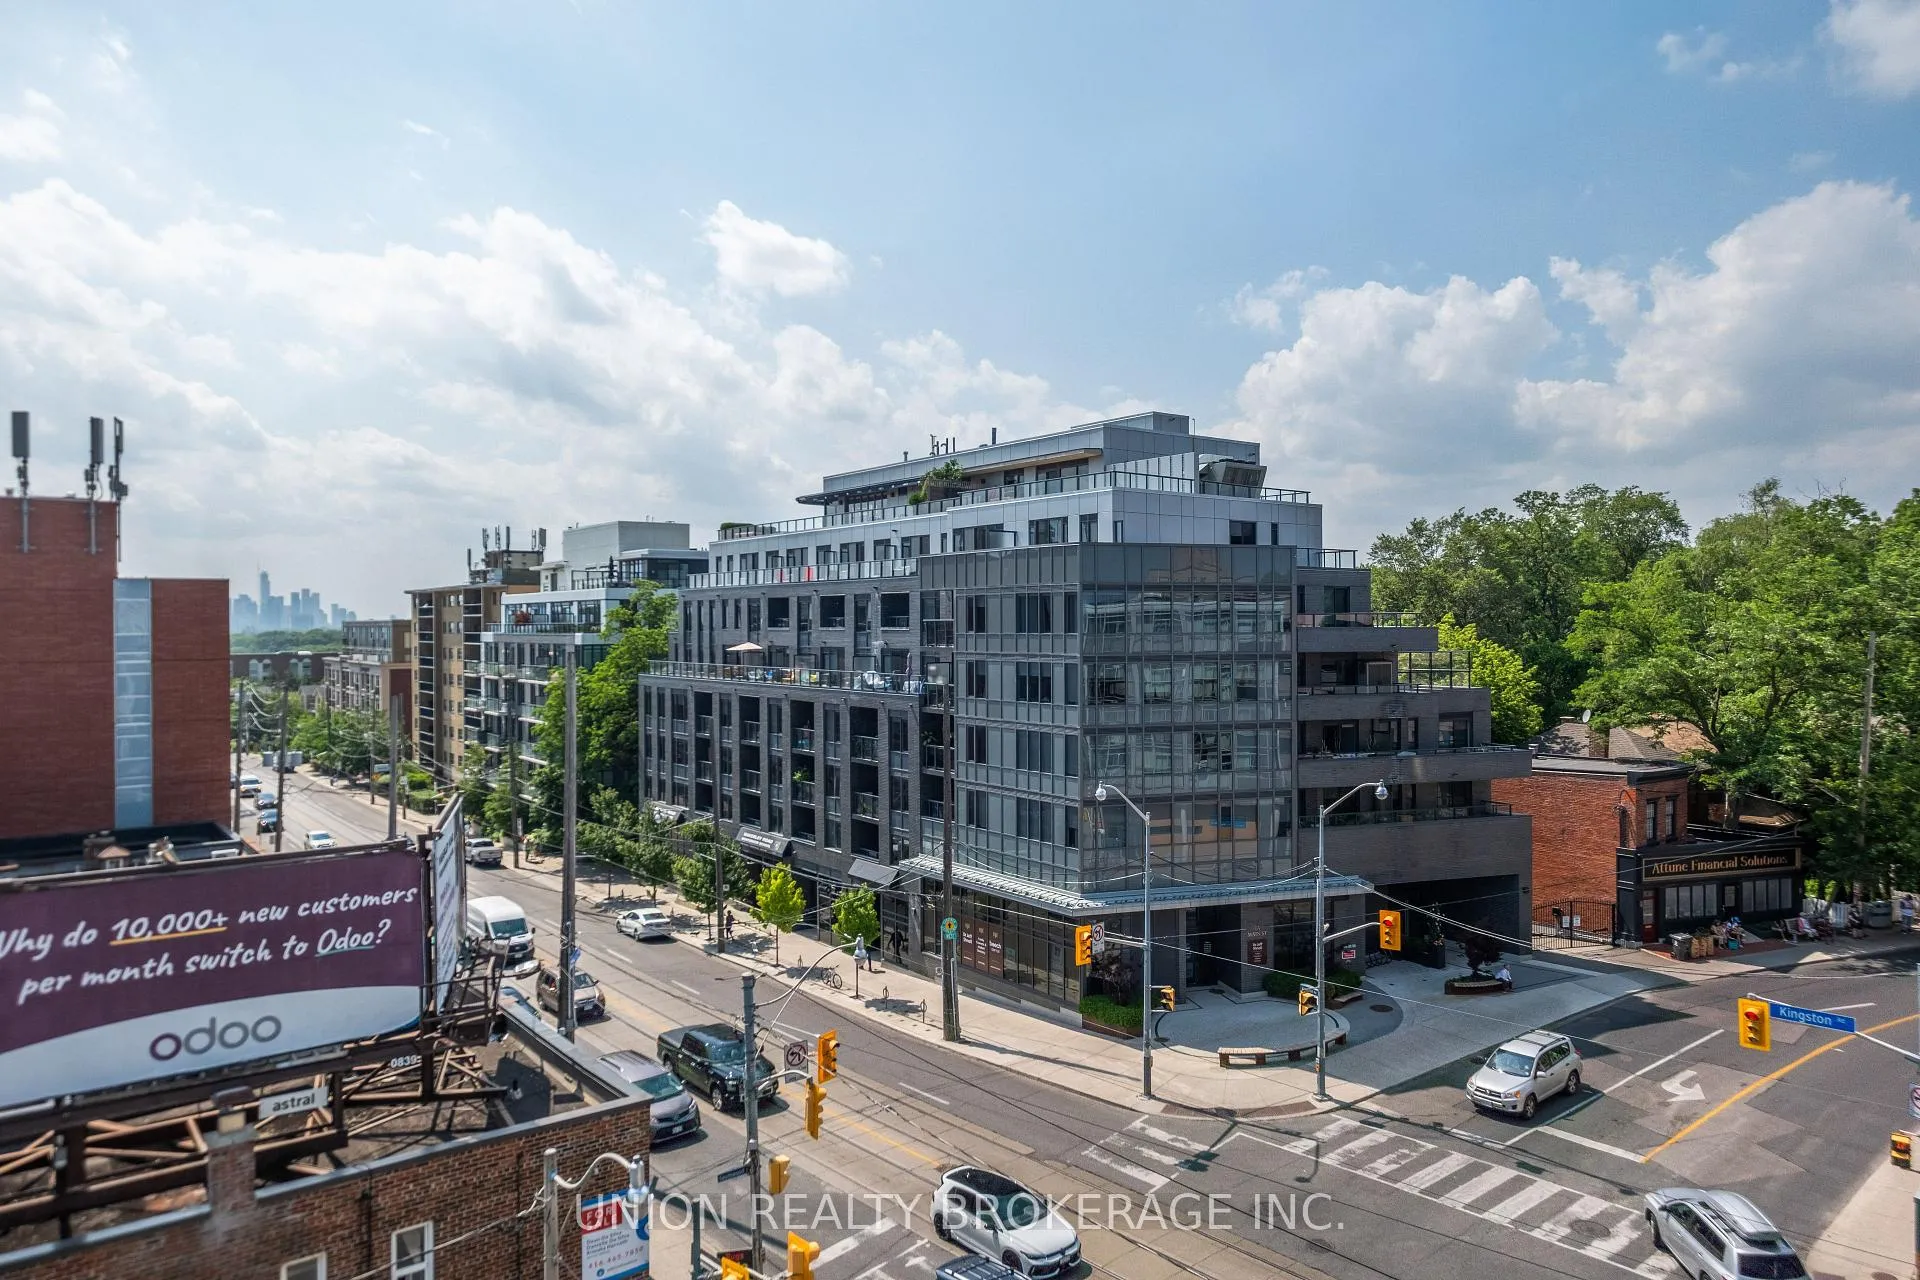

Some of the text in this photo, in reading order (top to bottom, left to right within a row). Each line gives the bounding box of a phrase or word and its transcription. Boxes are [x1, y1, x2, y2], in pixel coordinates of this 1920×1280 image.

[1652, 854, 1788, 875] Attune Financial Solutions
[62, 920, 98, 947] do
[111, 909, 228, 941] 10,000+
[238, 905, 289, 924] new
[298, 887, 418, 917] customers
[17, 918, 392, 1005] per month switch to Odoo?
[1779, 1006, 1832, 1026] Kingston
[149, 1015, 282, 1061] odoo
[272, 1092, 316, 1113] astral
